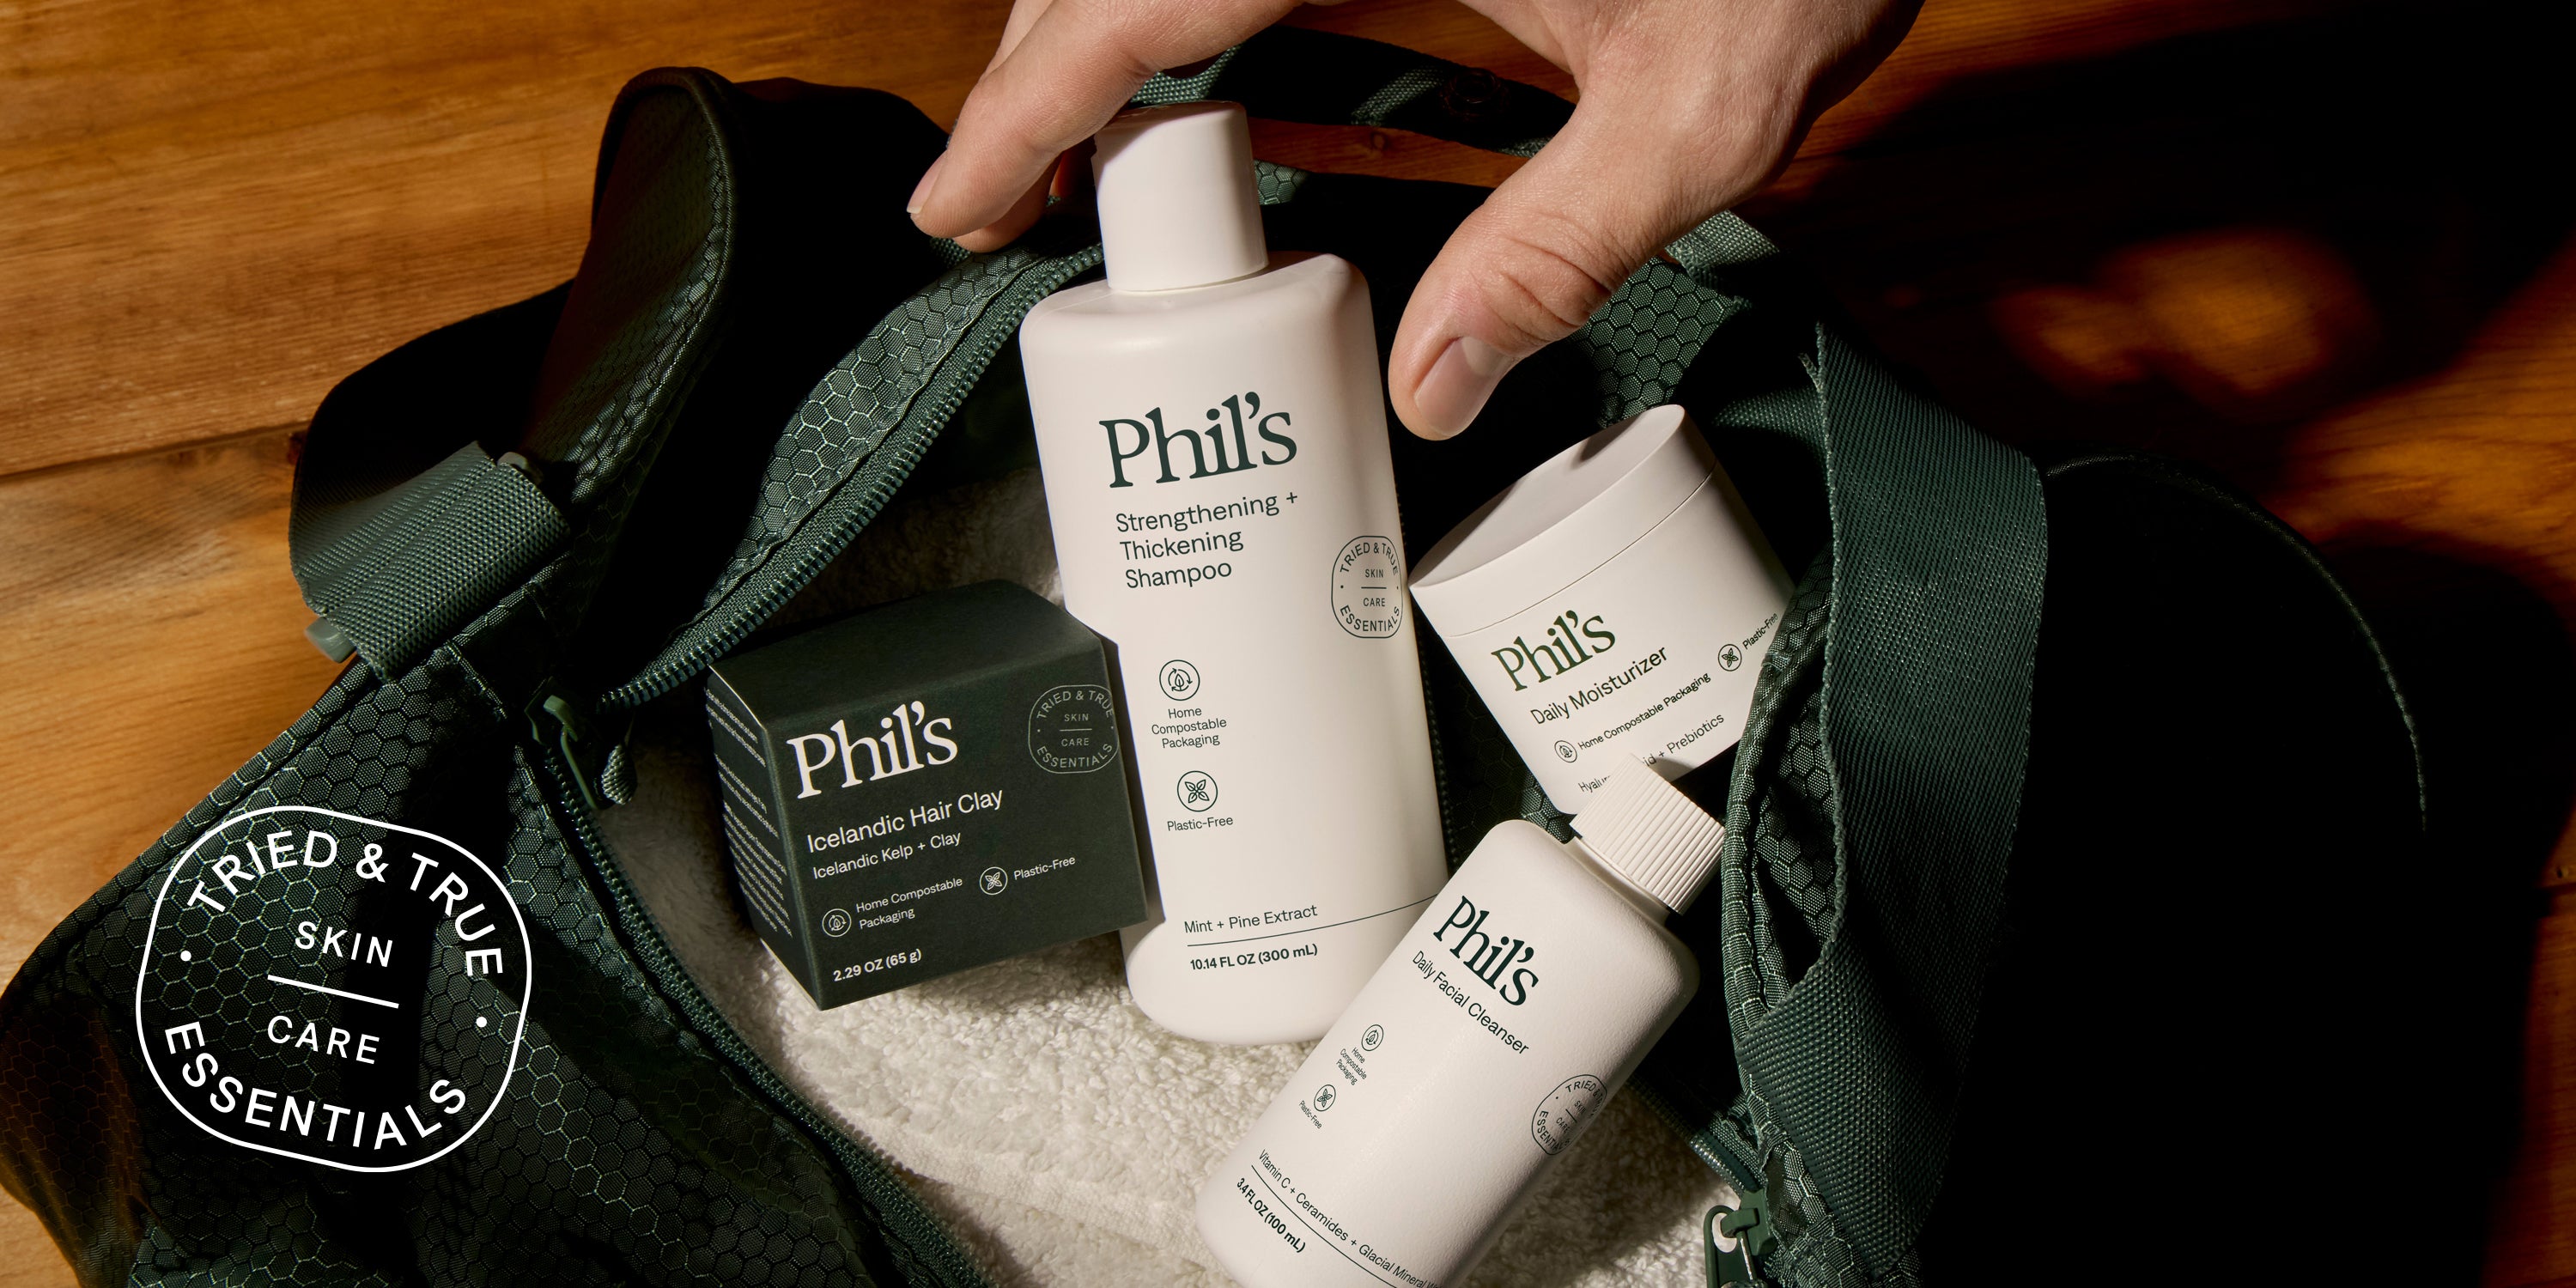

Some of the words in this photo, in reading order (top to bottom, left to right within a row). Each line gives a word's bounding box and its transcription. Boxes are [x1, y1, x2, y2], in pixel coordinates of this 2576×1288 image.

[1116, 494, 1279, 532] Strengthening
[1286, 492, 1298, 504] +
[1120, 530, 1244, 561] Thickening
[1340, 543, 1370, 573] TRIED
[1374, 543, 1380, 554] &
[1382, 543, 1398, 575] TRUE
[1125, 562, 1232, 589] Shampoo
[1365, 568, 1384, 578] SKIN
[1364, 598, 1386, 607] CARE
[1340, 605, 1400, 632] ESSENTIALS
[1742, 613, 1778, 650] Plastic-Free
[1530, 703, 1571, 725] Daily
[1569, 646, 1668, 711] Moisturizer
[1036, 690, 1072, 719] TRIED
[1075, 690, 1084, 701] &
[1089, 690, 1114, 718] TRUE
[1065, 714, 1089, 722] SKIN
[1168, 708, 1202, 720] Home
[1577, 730, 1604, 751] Home
[1603, 702, 1664, 740] Compostable
[1663, 671, 1711, 707] Packaging
[1151, 718, 1227, 736] Compostable
[1162, 732, 1221, 750] Packaging
[1667, 714, 1725, 754] Prebiotics
[1036, 744, 1113, 769] ESSENTIALS
[1061, 738, 1090, 747] CARE
[806, 814, 906, 854] Icelandic
[910, 800, 952, 827] Hair
[957, 789, 1004, 815] Clay
[1167, 816, 1234, 832] Plastic-Free
[812, 854, 879, 880] Icelandic
[881, 841, 914, 863] Kelp
[917, 841, 926, 851] +
[930, 832, 961, 850] Clay
[1013, 857, 1076, 881] Plastic-Free
[855, 897, 889, 914] Home
[890, 877, 963, 905] Compostable
[859, 908, 915, 930] Packaging
[1184, 919, 1213, 934] Mint
[1216, 920, 1225, 930] +
[1229, 914, 1261, 930] Pine
[1264, 904, 1318, 926] Extract
[833, 964, 862, 982] 2.29
[864, 957, 884, 974] OZ
[886, 951, 908, 970] (65
[908, 948, 922, 965] g)
[1190, 957, 1218, 971] 10.14
[1219, 955, 1235, 969] FL
[1236, 952, 1256, 966] OZ
[1258, 949, 1290, 966] (300
[1292, 943, 1318, 959] mL)
[1412, 950, 1437, 980] Daily
[1432, 971, 1471, 1008] Facial
[1467, 1002, 1530, 1054] Cleanser
[1340, 1048, 1367, 1080] Compostable
[1351, 1047, 1365, 1064] Home
[1336, 1059, 1358, 1086] Packaging
[1565, 1080, 1596, 1093] TRIED
[1298, 1100, 1322, 1129] Plastic-Free
[1556, 1117, 1571, 1133] CARE
[1236, 1177, 1249, 1194] 3.4
[1245, 1188, 1256, 1205] FL
[1254, 1200, 1269, 1218] OZ
[1264, 1212, 1288, 1236] (100
[1284, 1231, 1306, 1254] mL)
[1259, 1149, 1282, 1182] Vitamin
[1281, 1177, 1291, 1189] C
[1296, 1193, 1349, 1242] Ceramides
[1350, 1238, 1358, 1247] +
[1358, 1243, 1396, 1272] Glacial
[1392, 1265, 1428, 1288] Mineral
